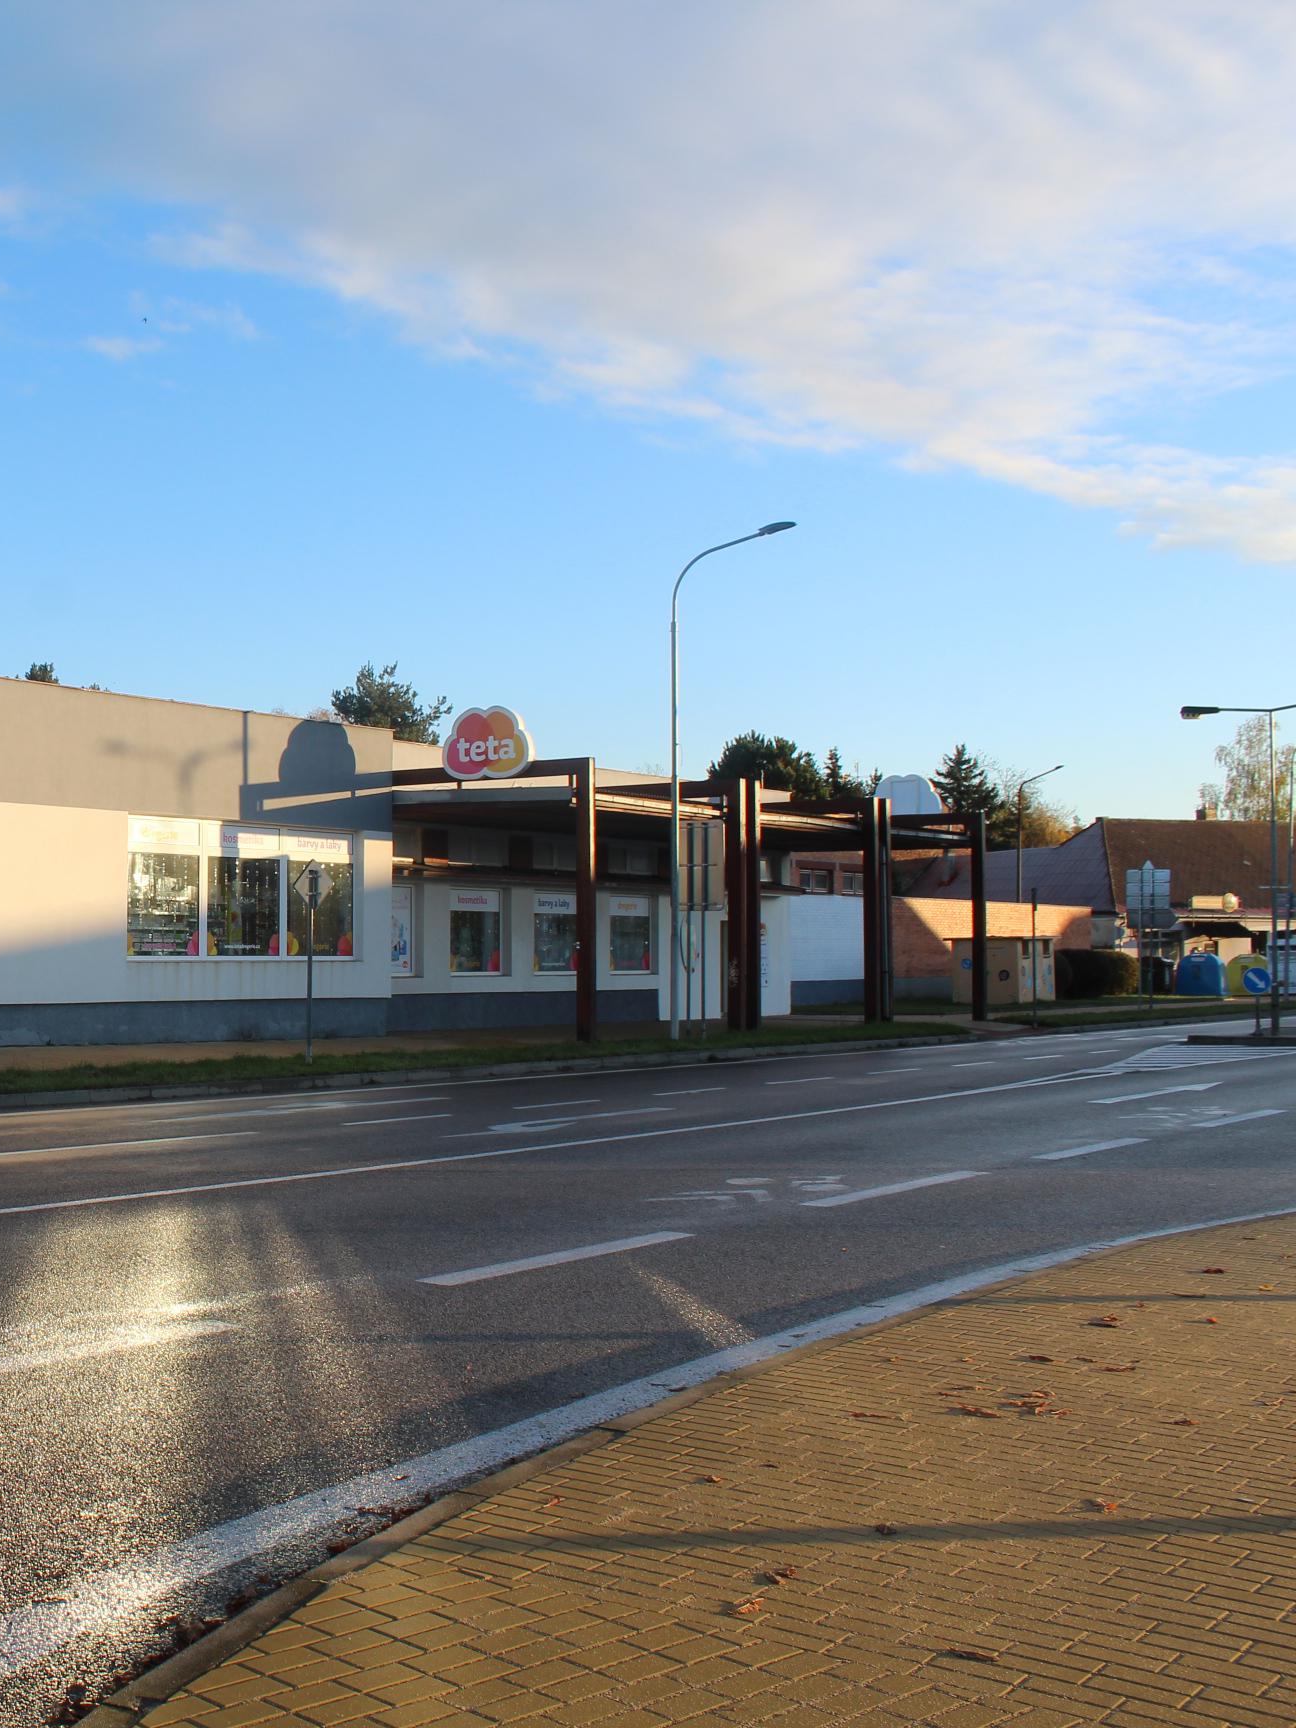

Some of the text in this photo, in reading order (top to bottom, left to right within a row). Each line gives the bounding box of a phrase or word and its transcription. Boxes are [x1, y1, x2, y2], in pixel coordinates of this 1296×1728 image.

[457, 736, 516, 762] teta
[297, 835, 319, 850] barvy
[326, 839, 341, 852] laky
[457, 895, 488, 905] kosmetika
[537, 898, 553, 909] barvy
[559, 899, 570, 910] laky
